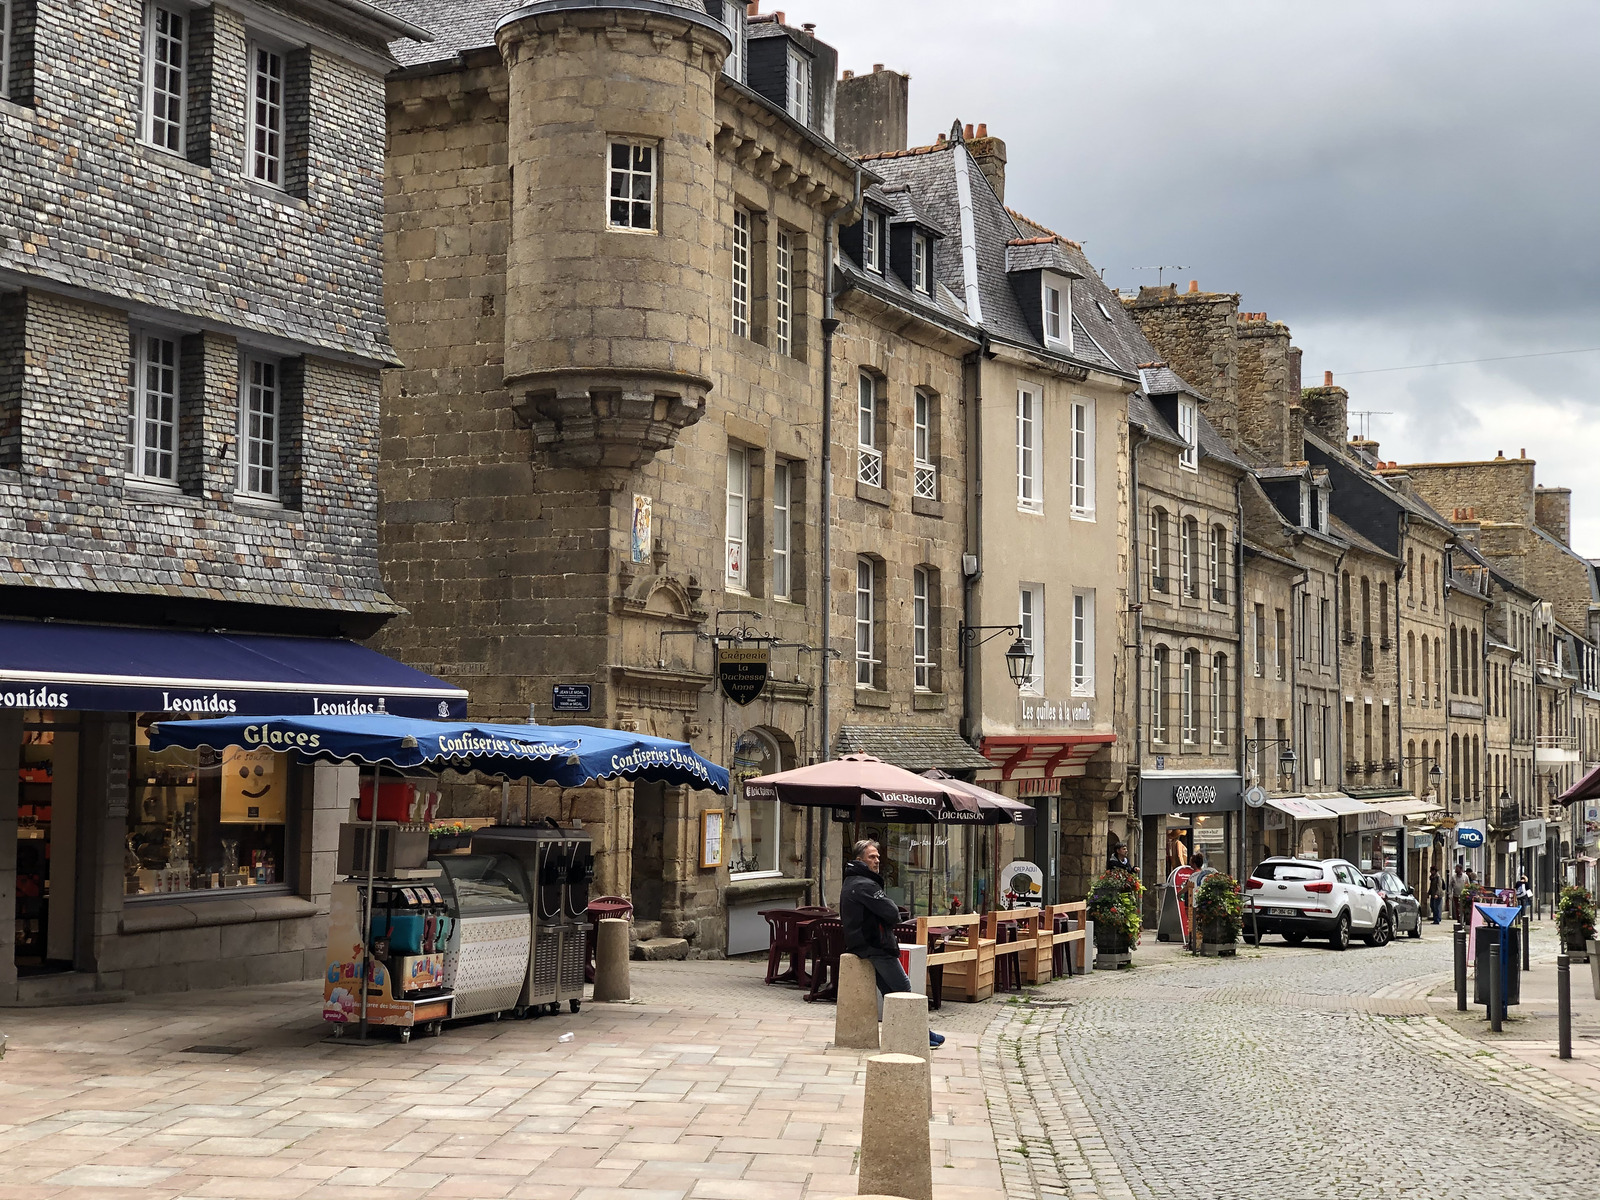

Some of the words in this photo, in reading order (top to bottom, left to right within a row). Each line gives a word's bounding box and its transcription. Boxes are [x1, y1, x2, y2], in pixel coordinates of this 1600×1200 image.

[720, 650, 767, 661] Crêperie
[721, 673, 765, 681] Duchesse
[738, 664, 749, 672] La
[0, 685, 69, 708] onidas
[731, 683, 755, 691] Anne
[162, 691, 237, 713] Leonidas
[312, 697, 374, 715] Leonidas
[1022, 699, 1034, 720] Les
[1036, 700, 1057, 726] quilles
[1058, 700, 1063, 720] à
[1064, 701, 1070, 720] la
[1071, 701, 1091, 721] vanille
[243, 723, 321, 748] Glaces
[438, 732, 509, 752] Confiseries
[611, 746, 669, 770] Confiseries
[902, 794, 937, 806] Raison
[1459, 832, 1482, 842] ATOL
[327, 961, 385, 986] Granta
